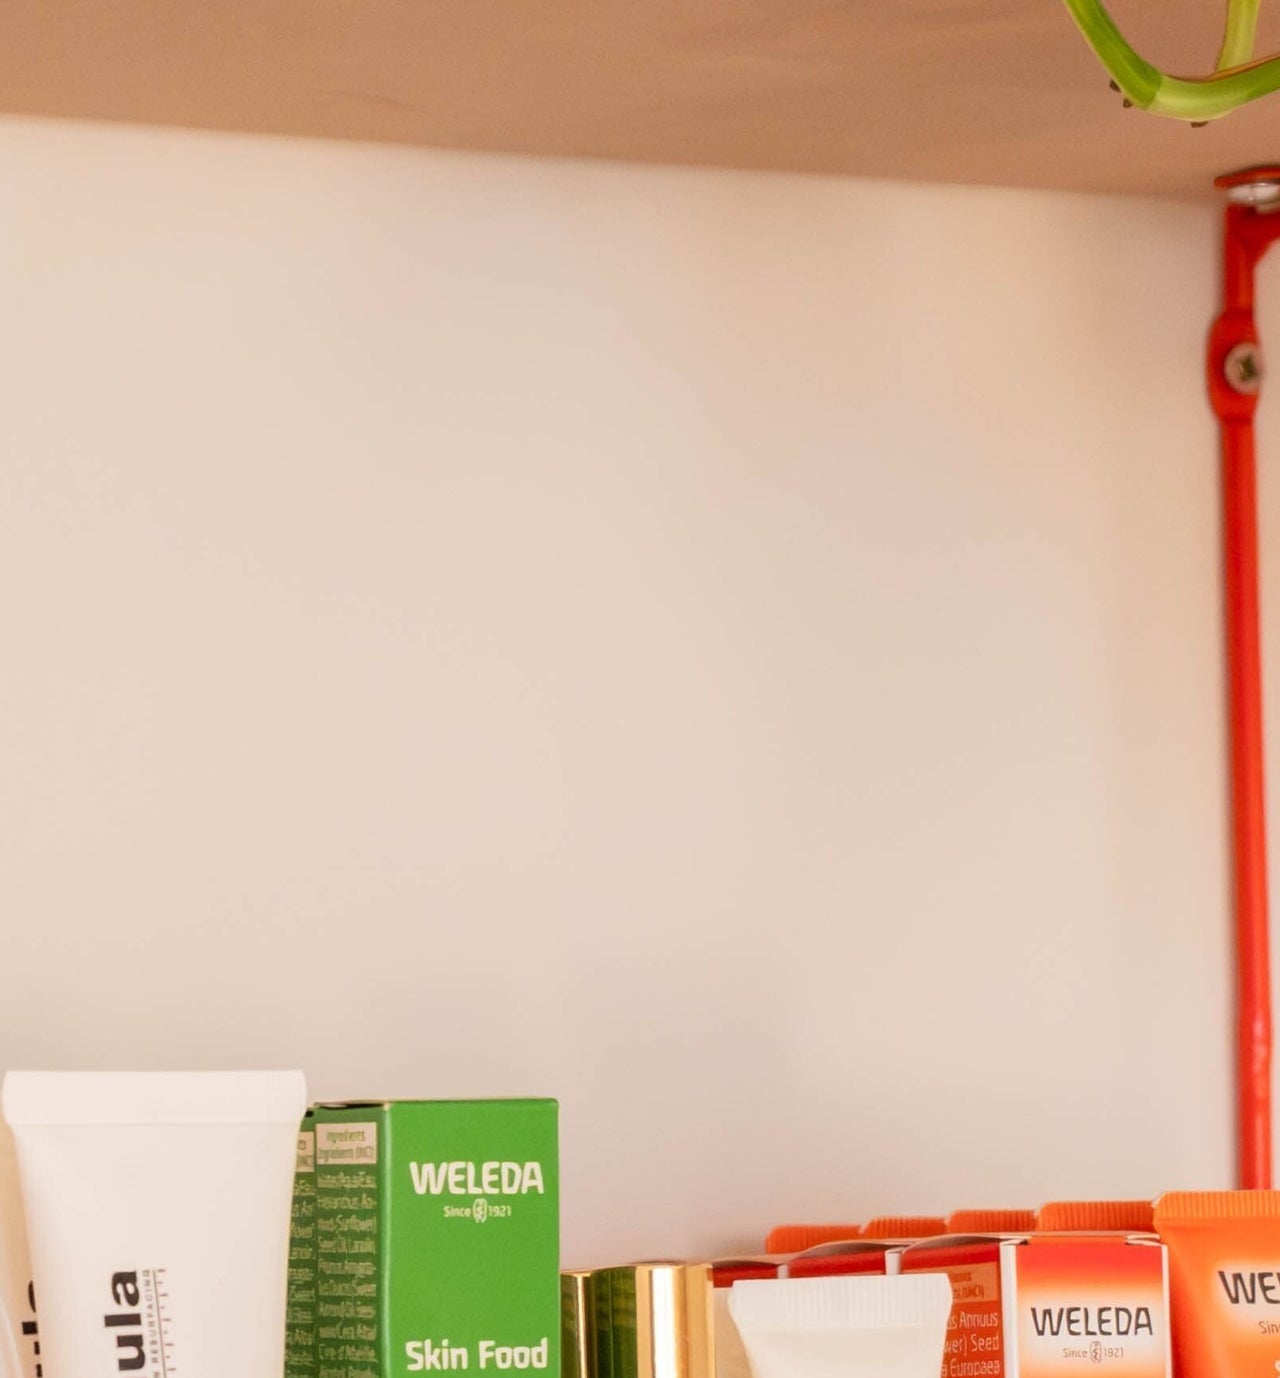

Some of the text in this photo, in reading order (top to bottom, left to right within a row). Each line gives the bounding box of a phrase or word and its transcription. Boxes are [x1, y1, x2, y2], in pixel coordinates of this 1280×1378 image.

[410, 1161, 545, 1196] WELEDA
[443, 1204, 512, 1218] Since 1921
[1030, 1306, 1153, 1336] WELEDA
[405, 1337, 548, 1371] Skin Food
[1062, 1346, 1124, 1358] Since 1921
